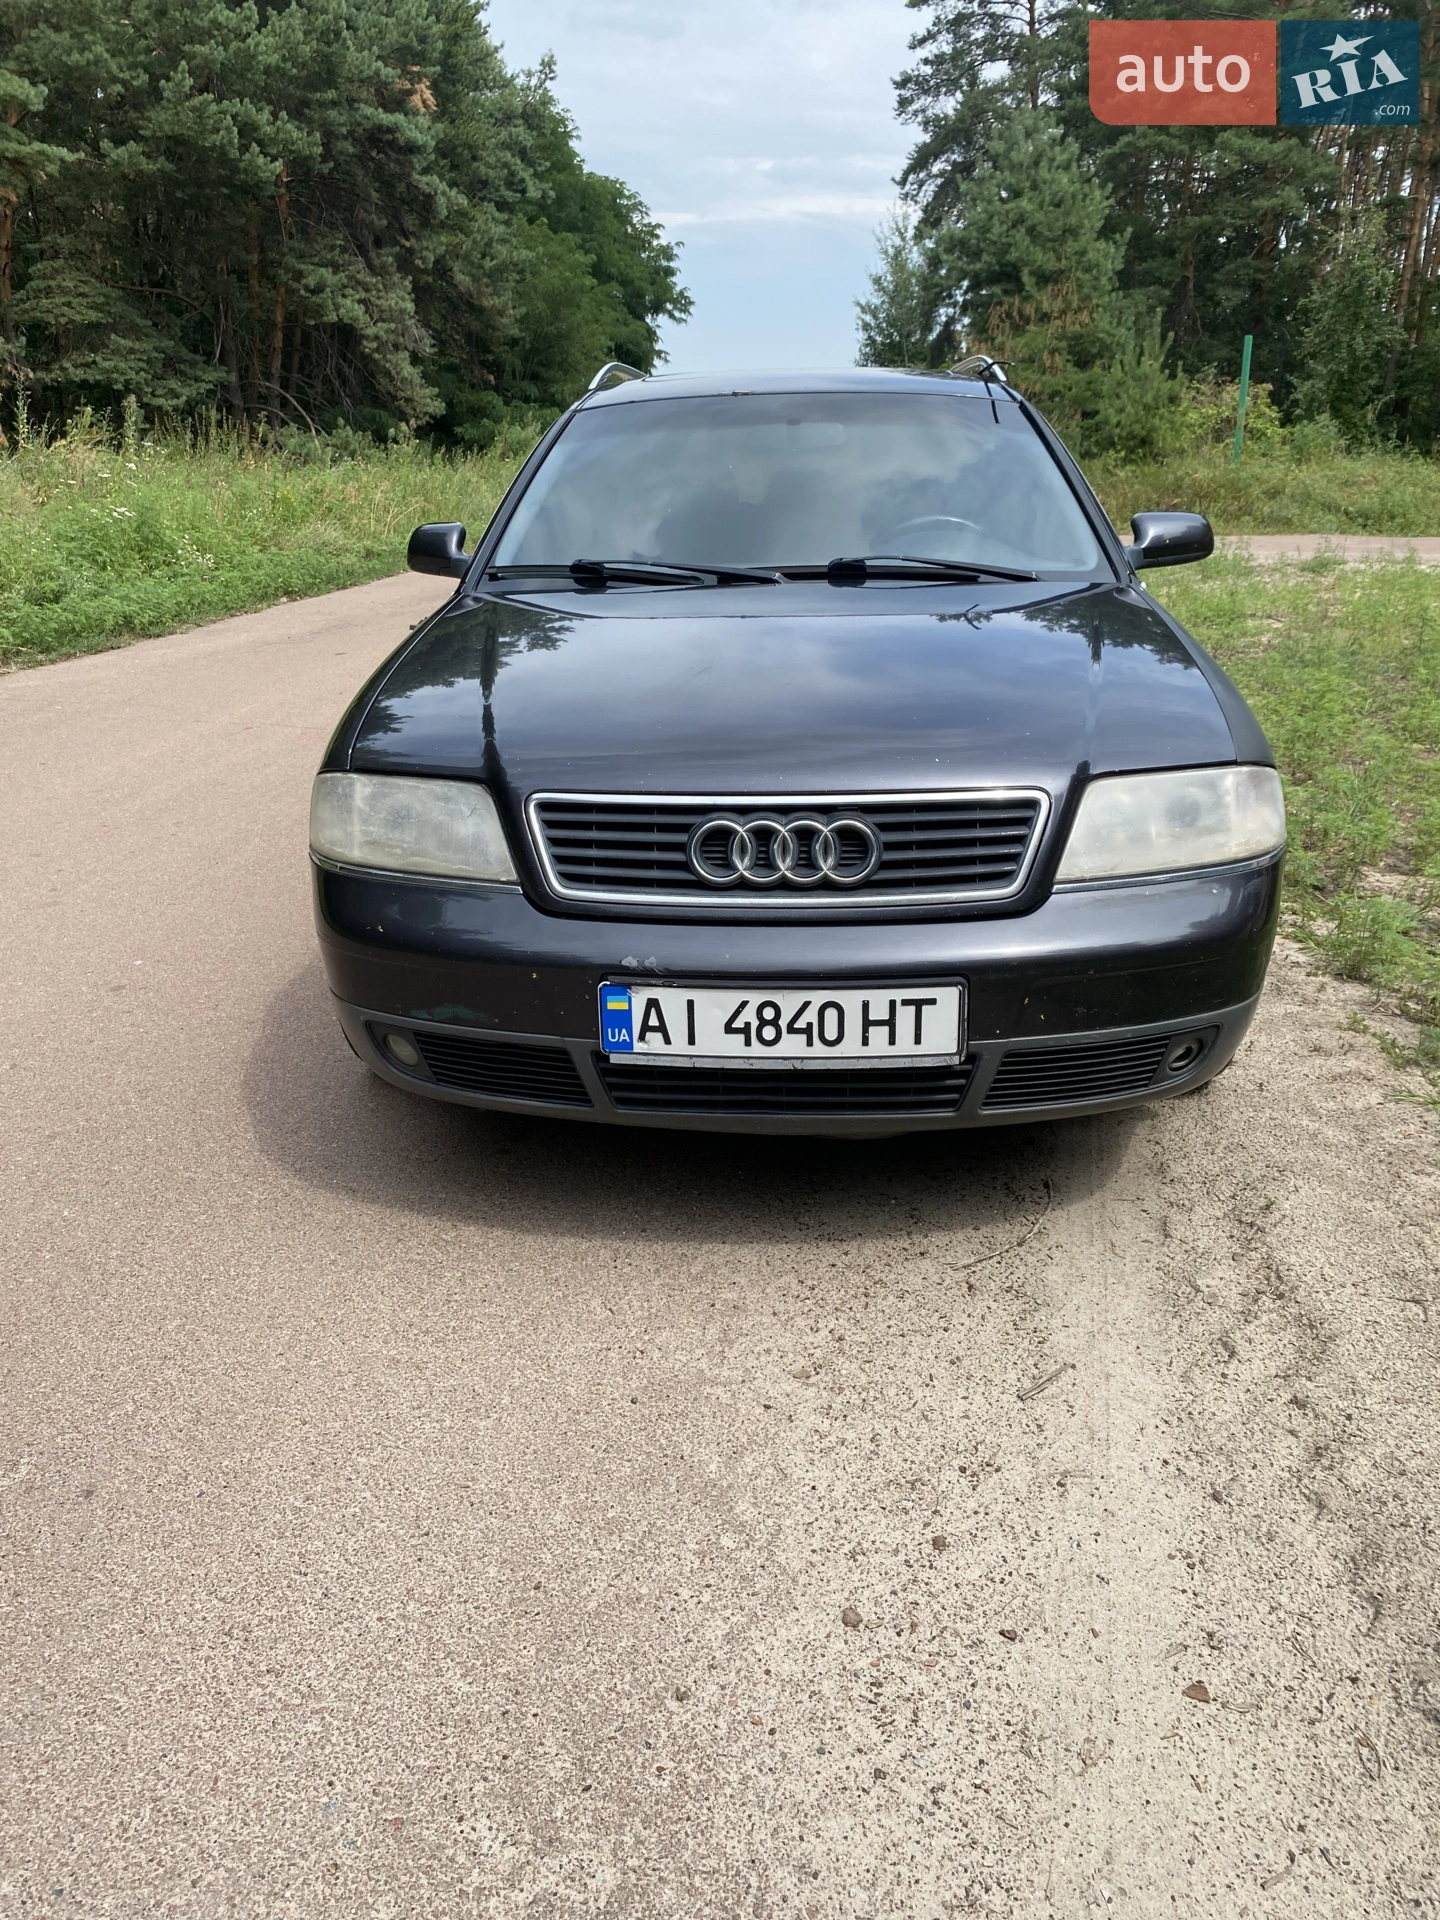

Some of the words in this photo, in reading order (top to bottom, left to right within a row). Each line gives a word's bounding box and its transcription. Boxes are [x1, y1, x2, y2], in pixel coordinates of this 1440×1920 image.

[608, 1028, 630, 1043] UA
[637, 997, 697, 1046] AI
[724, 1000, 846, 1047] 4840
[861, 997, 938, 1047] HT
